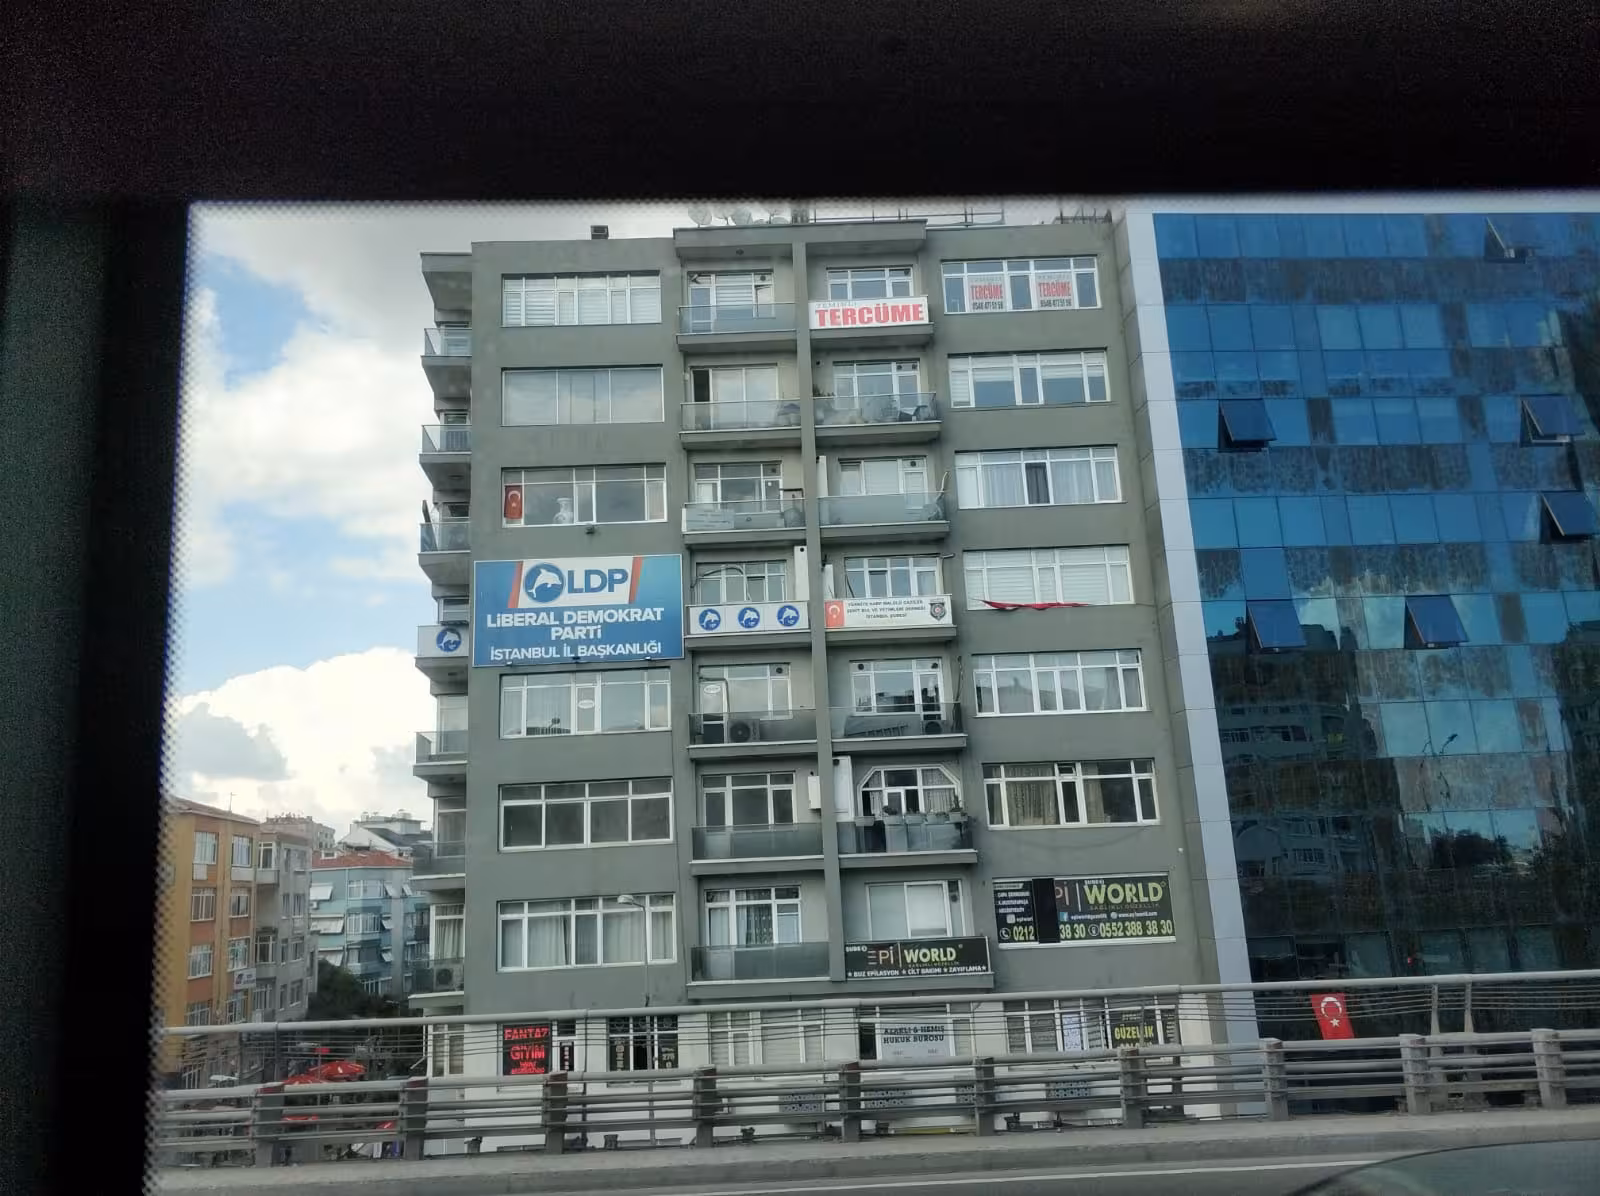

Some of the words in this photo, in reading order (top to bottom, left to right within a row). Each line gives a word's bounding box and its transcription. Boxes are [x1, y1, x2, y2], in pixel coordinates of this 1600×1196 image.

[970, 283, 1003, 300] TERCÜME
[1038, 280, 1072, 298] TERCÜME
[815, 303, 925, 327] TERCÜME
[567, 568, 628, 594] LDP
[564, 608, 664, 624] DEMOKRAT
[490, 644, 560, 661] İSTANBUL
[562, 642, 575, 656] İL
[578, 640, 662, 659] BAŞKANLIĞI
[1084, 882, 1163, 904] WORLD
[1012, 926, 1034, 940] 0212
[1074, 924, 1086, 938] 30
[1100, 922, 1124, 938] 0552
[1125, 921, 1142, 936] 388
[1146, 920, 1158, 934] 38
[1160, 920, 1172, 934] 30
[904, 948, 956, 963] WORLD
[884, 1036, 911, 1044] HUKUK
